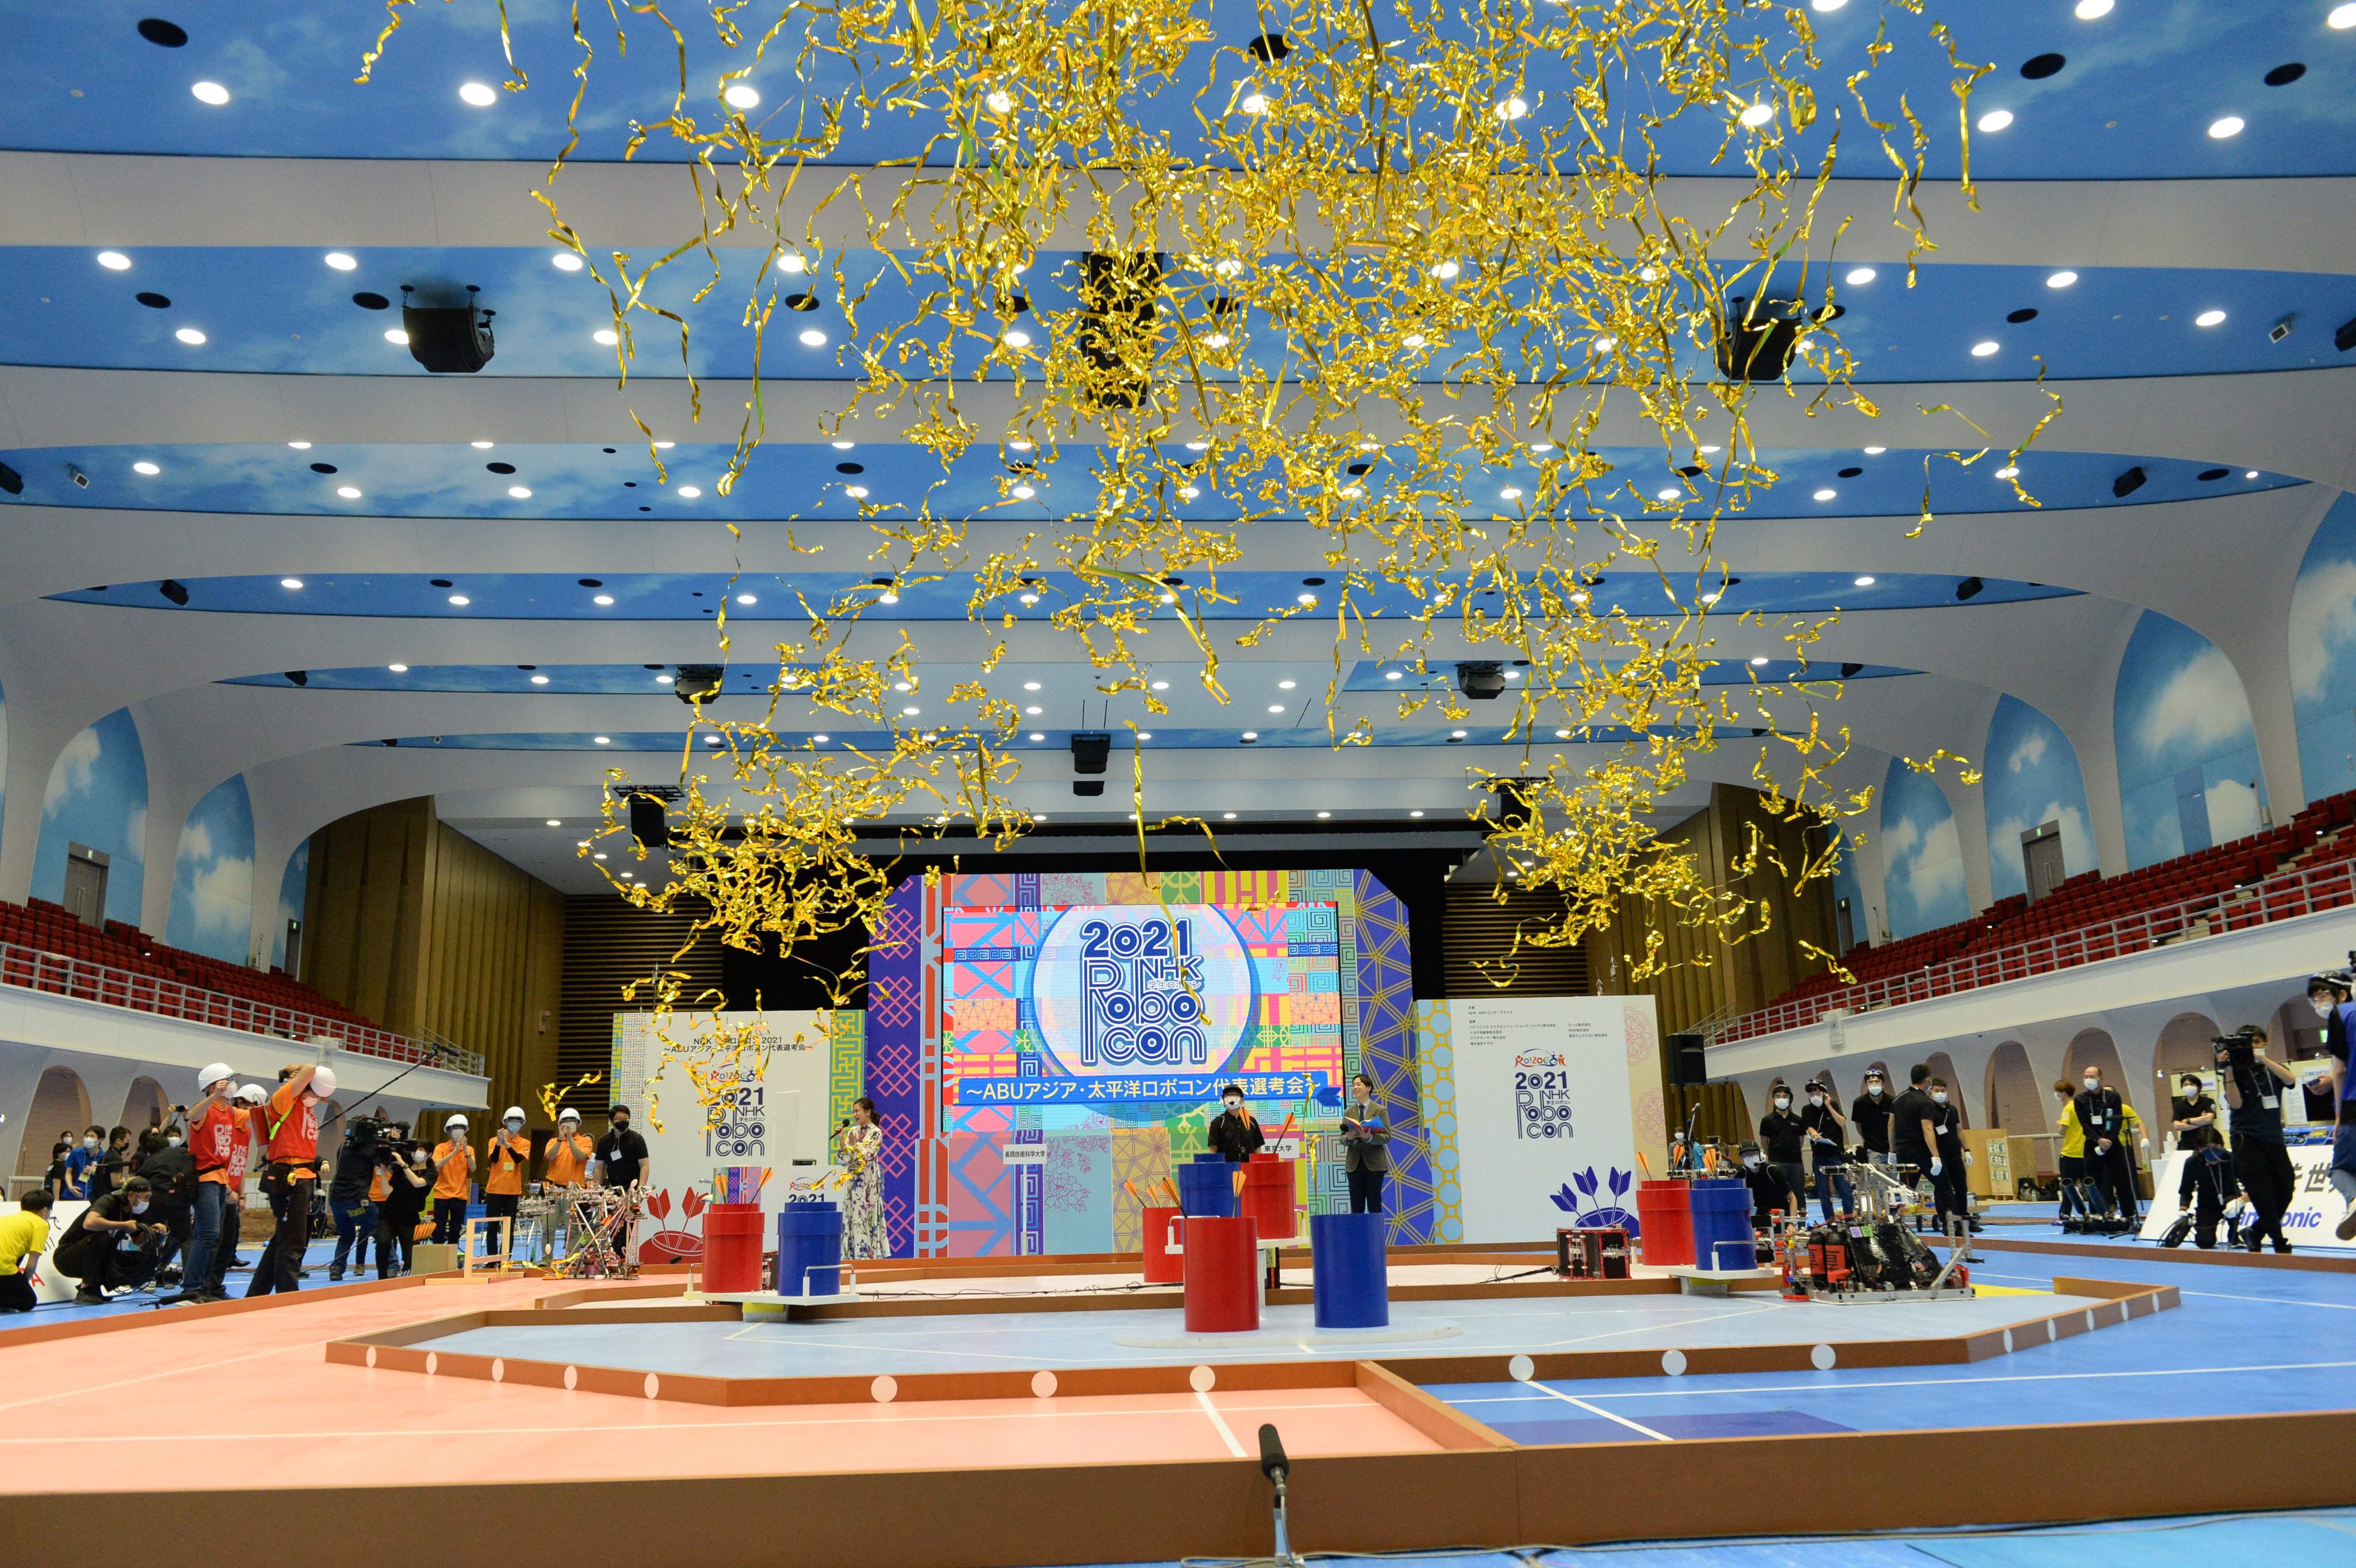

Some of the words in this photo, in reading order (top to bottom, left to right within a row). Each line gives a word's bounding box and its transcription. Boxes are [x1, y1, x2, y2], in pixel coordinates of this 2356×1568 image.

[1083, 919, 1190, 958] 2021
[1141, 957, 1202, 980] NHK
[1514, 1071, 1567, 1089] 2021
[1542, 1089, 1570, 1100] NHK
[736, 1106, 765, 1116] NHK
[789, 1194, 824, 1203] 2021
